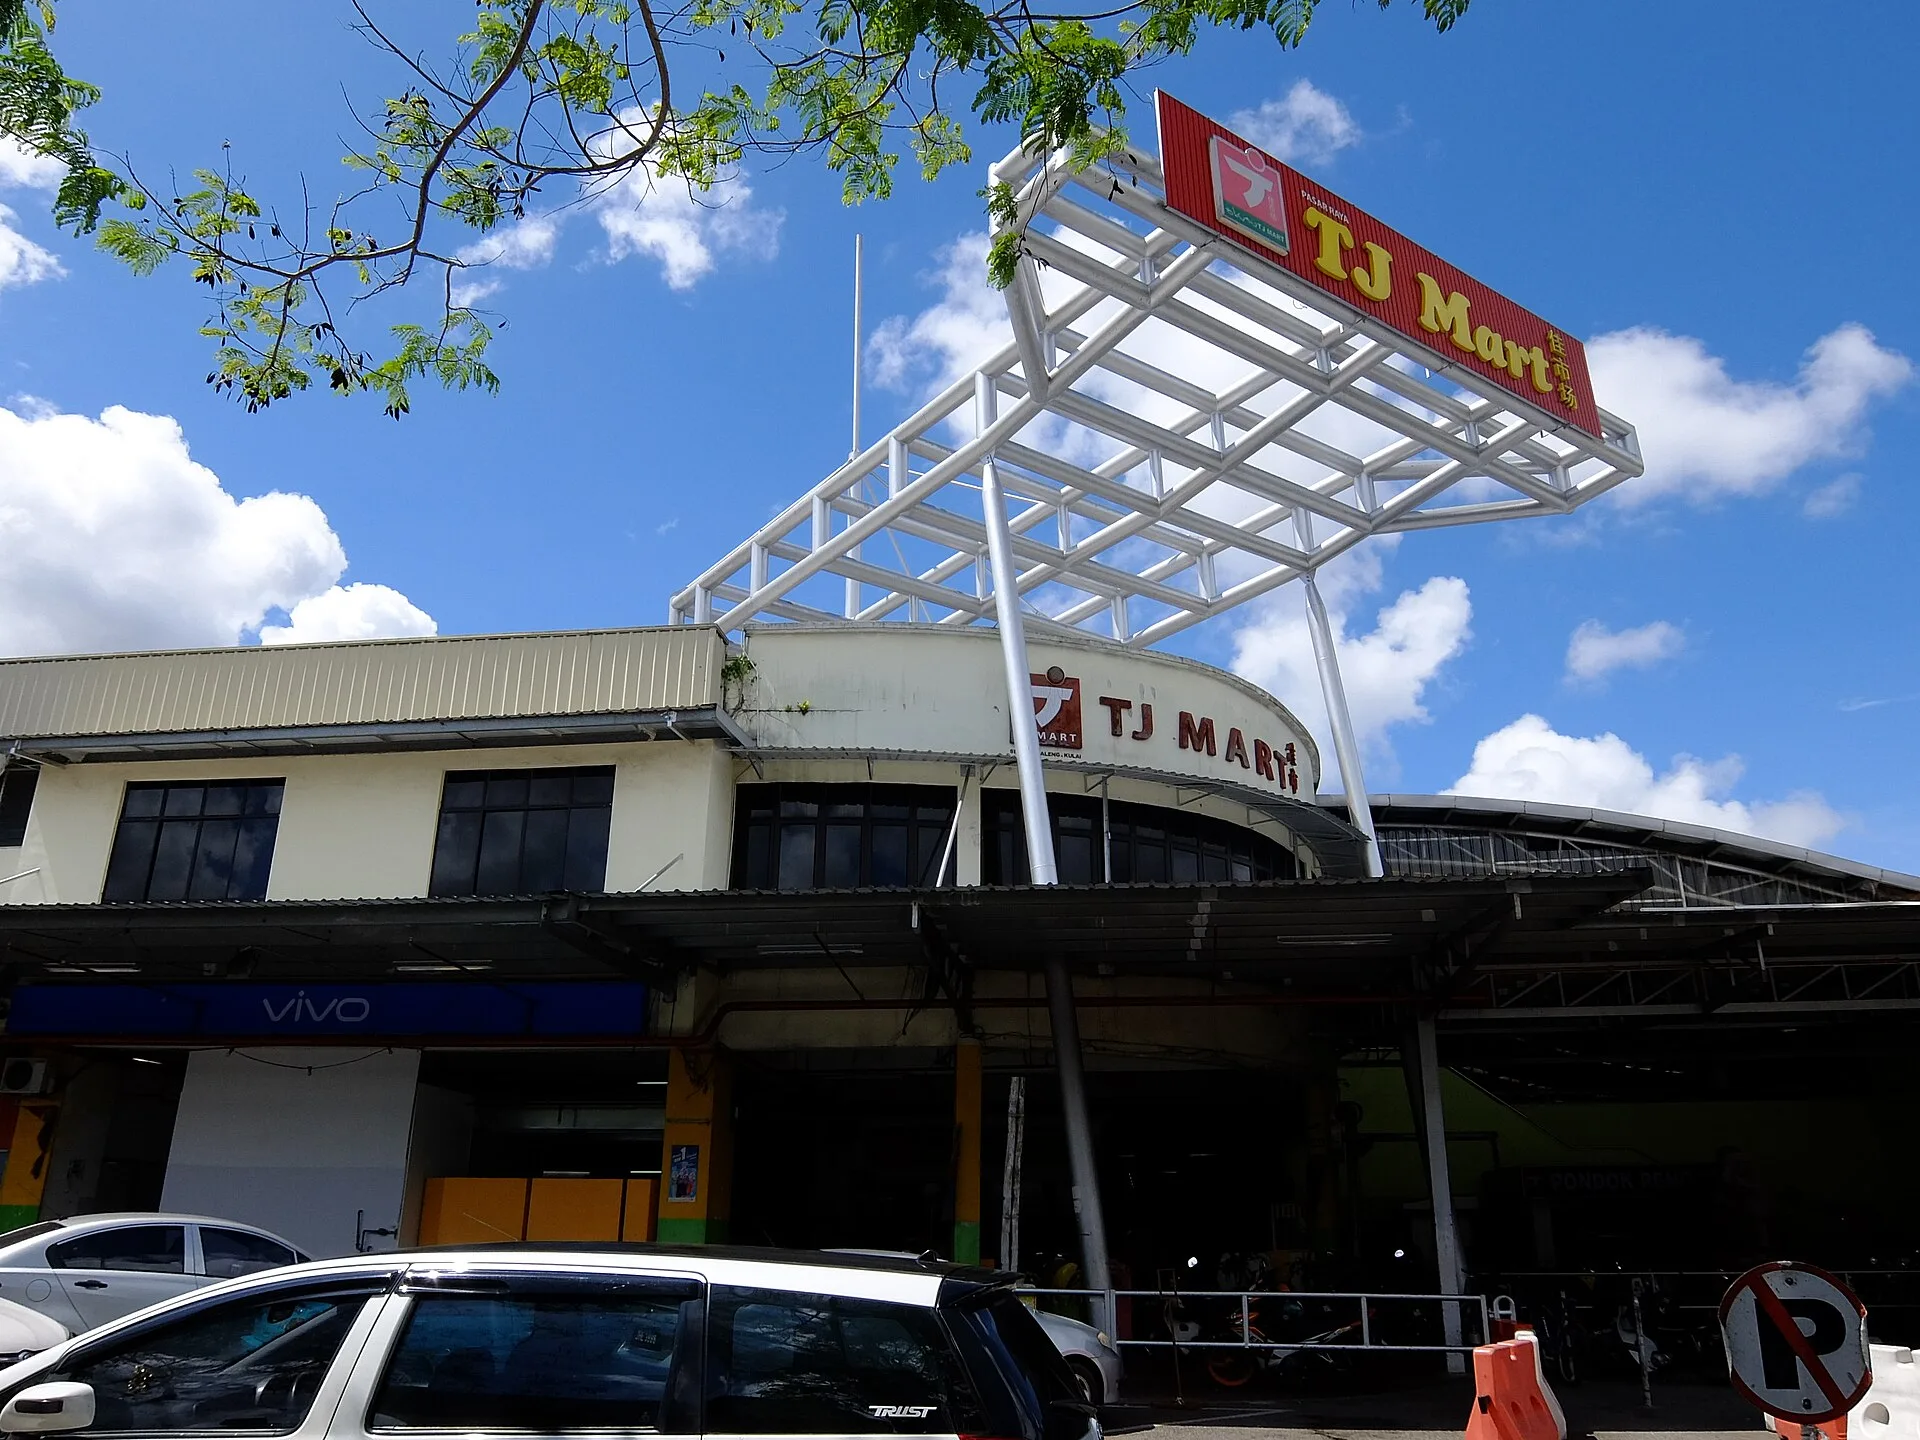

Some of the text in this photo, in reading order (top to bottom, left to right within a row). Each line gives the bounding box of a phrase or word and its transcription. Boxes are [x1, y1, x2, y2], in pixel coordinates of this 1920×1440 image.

[1301, 189, 1328, 212] PASAR
[1329, 205, 1350, 225] RAYA
[1303, 207, 1553, 394] TJ Mart
[1038, 731, 1077, 743] MART
[1099, 695, 1287, 790] TJ MART
[263, 990, 370, 1022] vivo
[1550, 1172, 1634, 1190] PONDOK
[1754, 1297, 1847, 1390] P
[868, 1405, 938, 1418] TRUST
